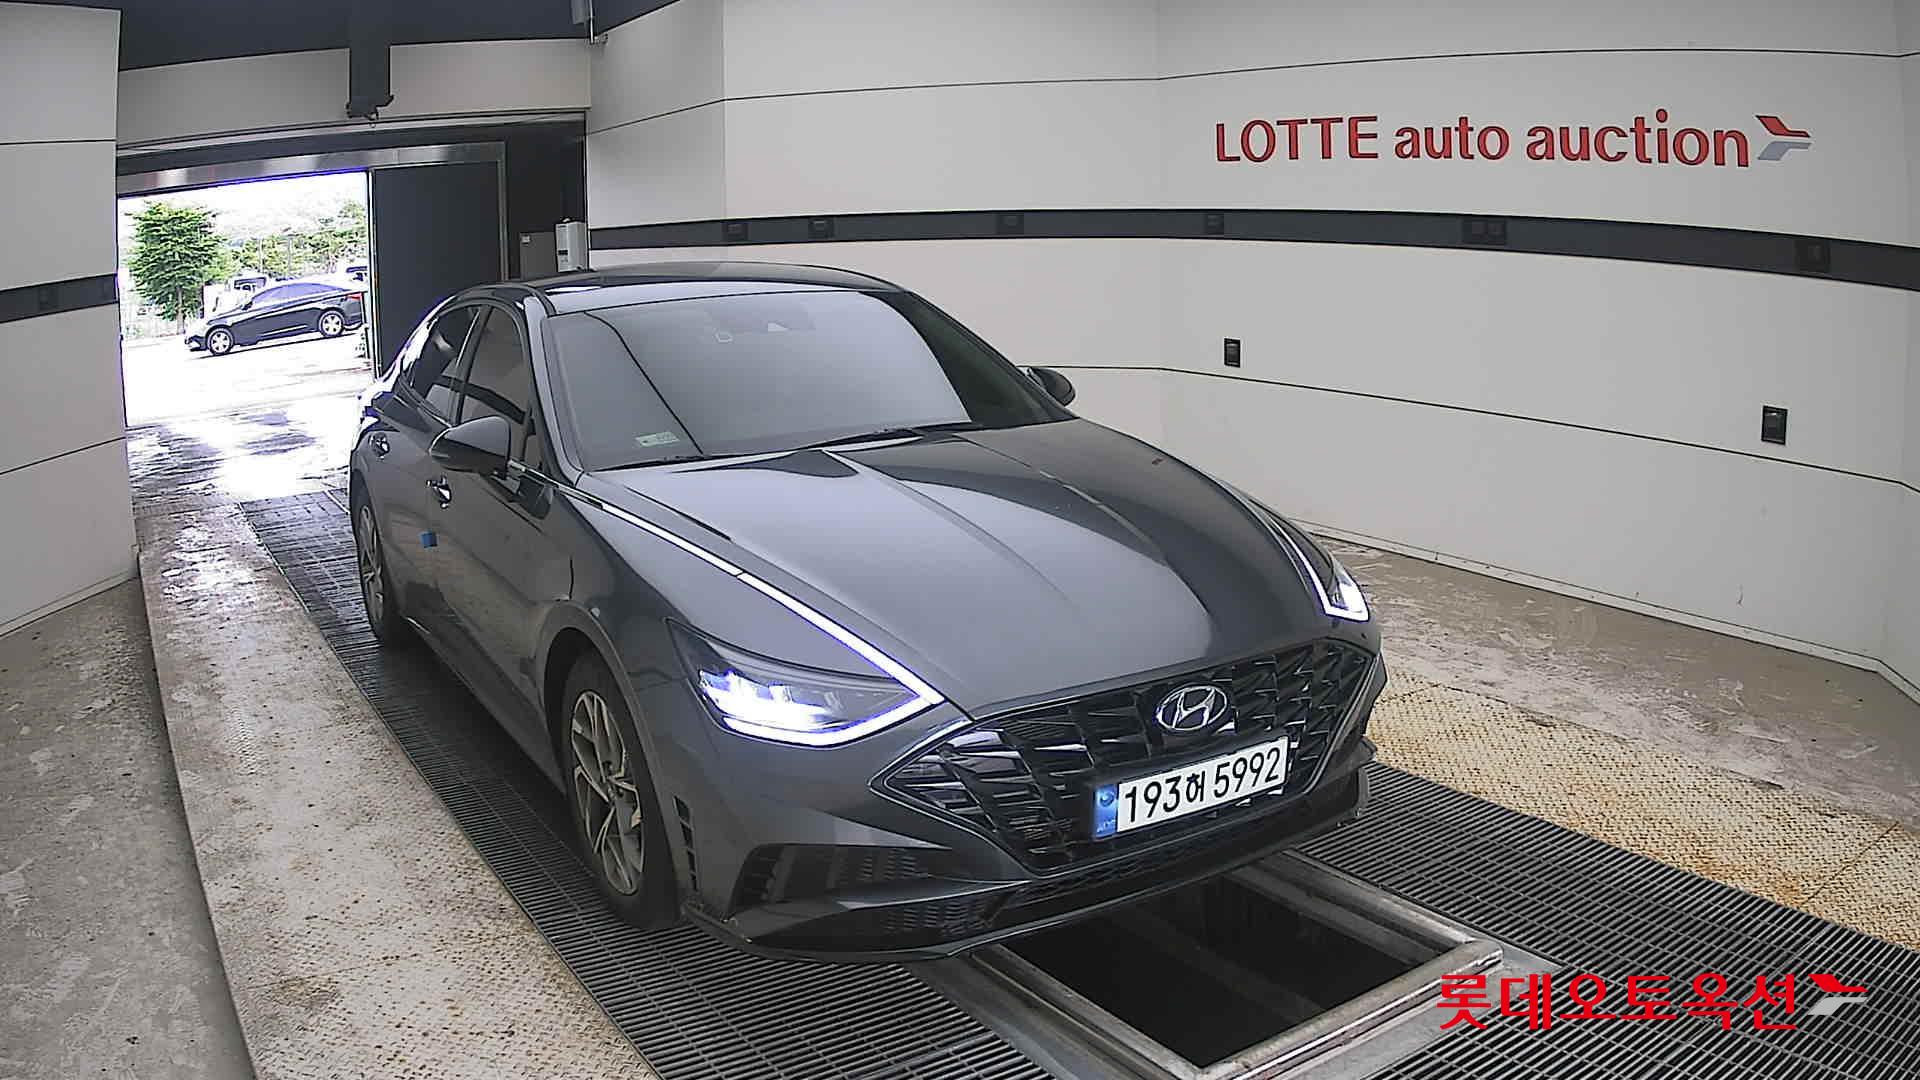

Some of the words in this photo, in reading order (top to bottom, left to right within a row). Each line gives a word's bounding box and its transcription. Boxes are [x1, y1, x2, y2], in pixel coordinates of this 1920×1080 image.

[1215, 115, 1379, 162] LOTTE
[1395, 116, 1511, 160] auto
[1526, 109, 1750, 167] auction
[1125, 771, 1206, 823] 193허
[1213, 747, 1281, 798] 5992
